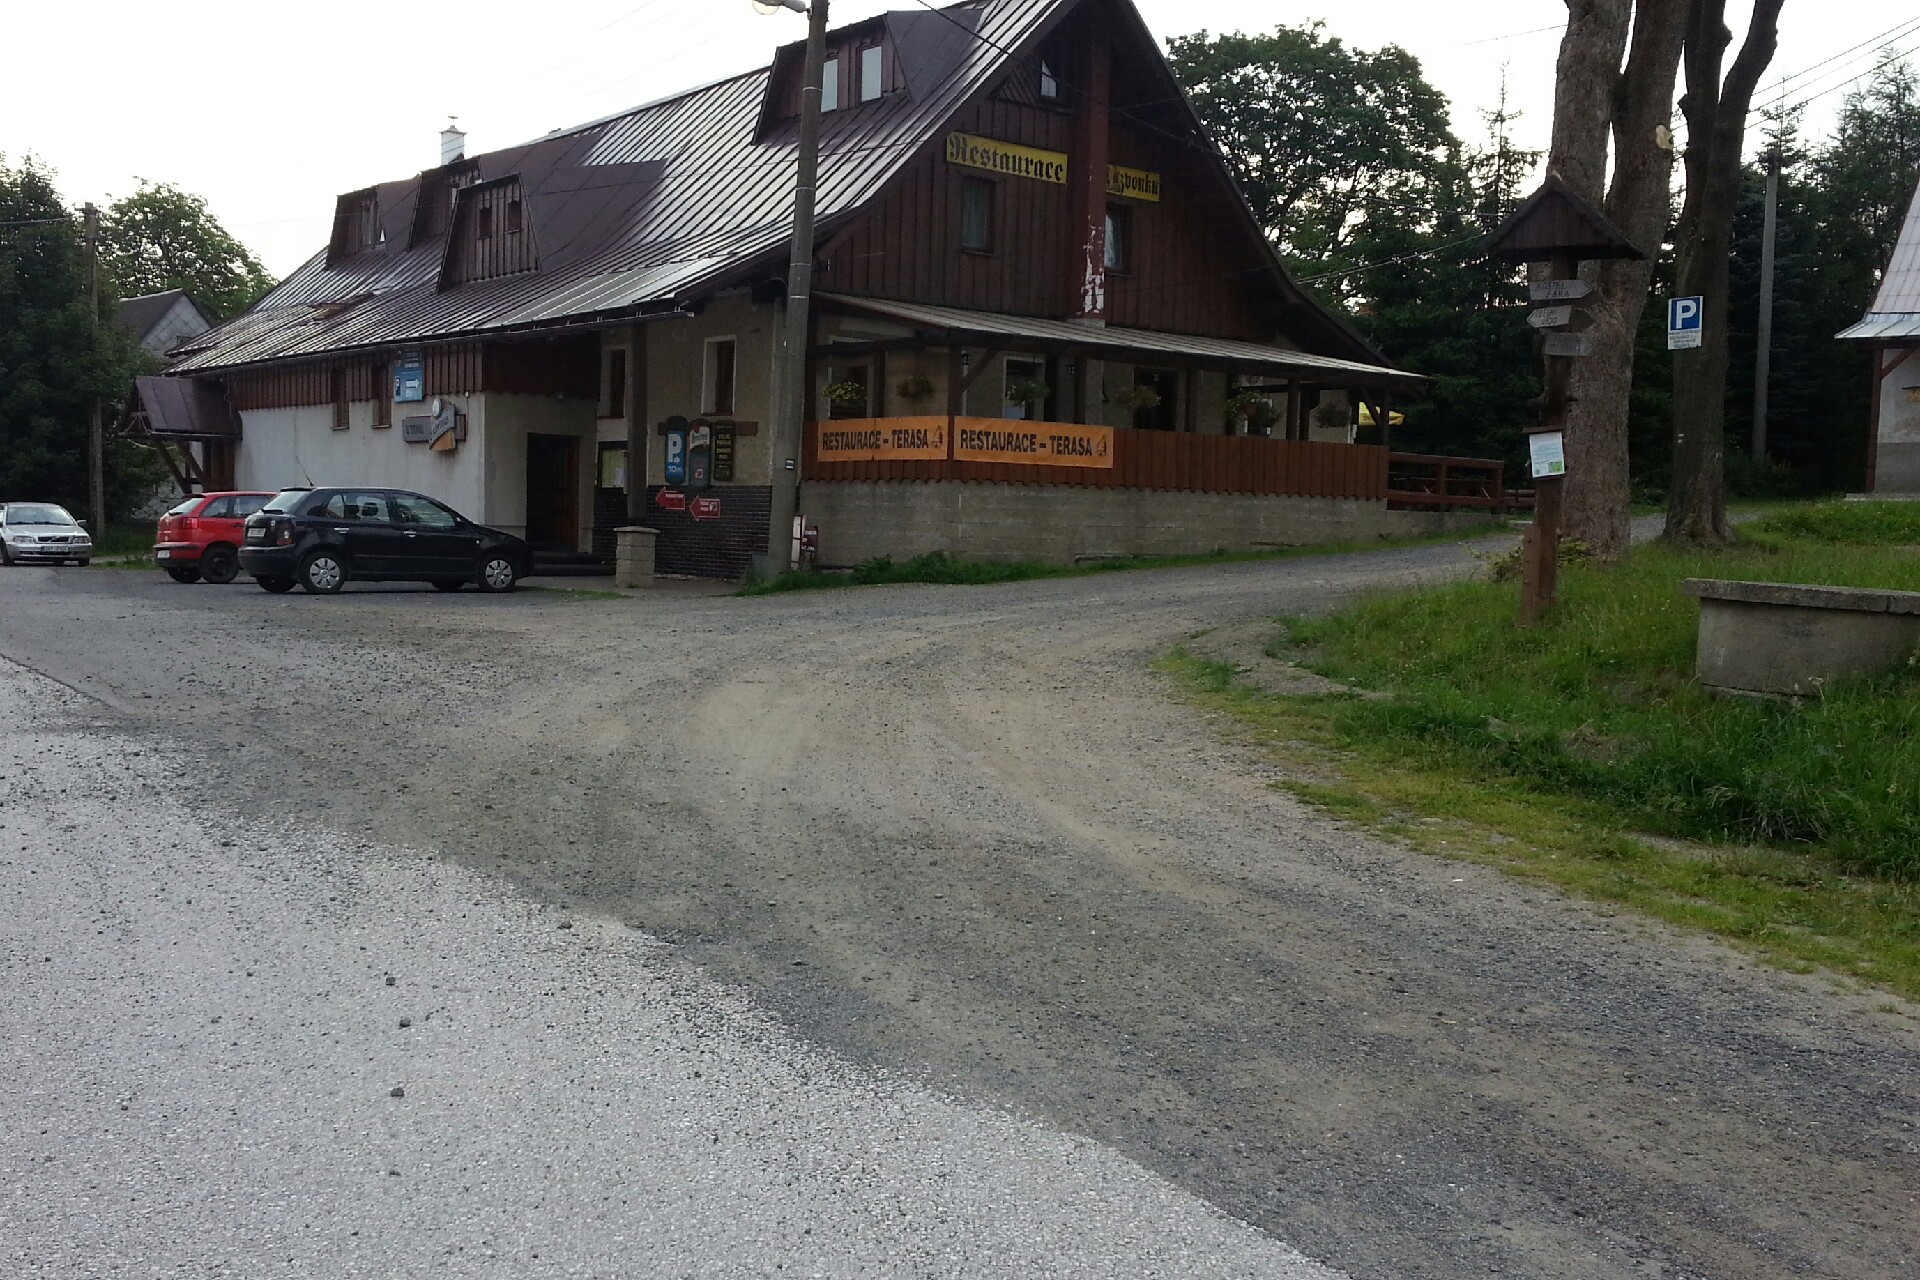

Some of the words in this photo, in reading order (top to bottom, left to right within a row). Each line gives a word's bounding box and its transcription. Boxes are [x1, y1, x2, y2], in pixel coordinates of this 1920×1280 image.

[949, 134, 1063, 181] Restaurace
[1676, 300, 1696, 329] P
[668, 433, 682, 463] P
[822, 429, 881, 451] RESTAURACE
[892, 428, 929, 449] TERASA
[960, 428, 1037, 453] RESTAURACE
[1049, 434, 1093, 457] TERASA
